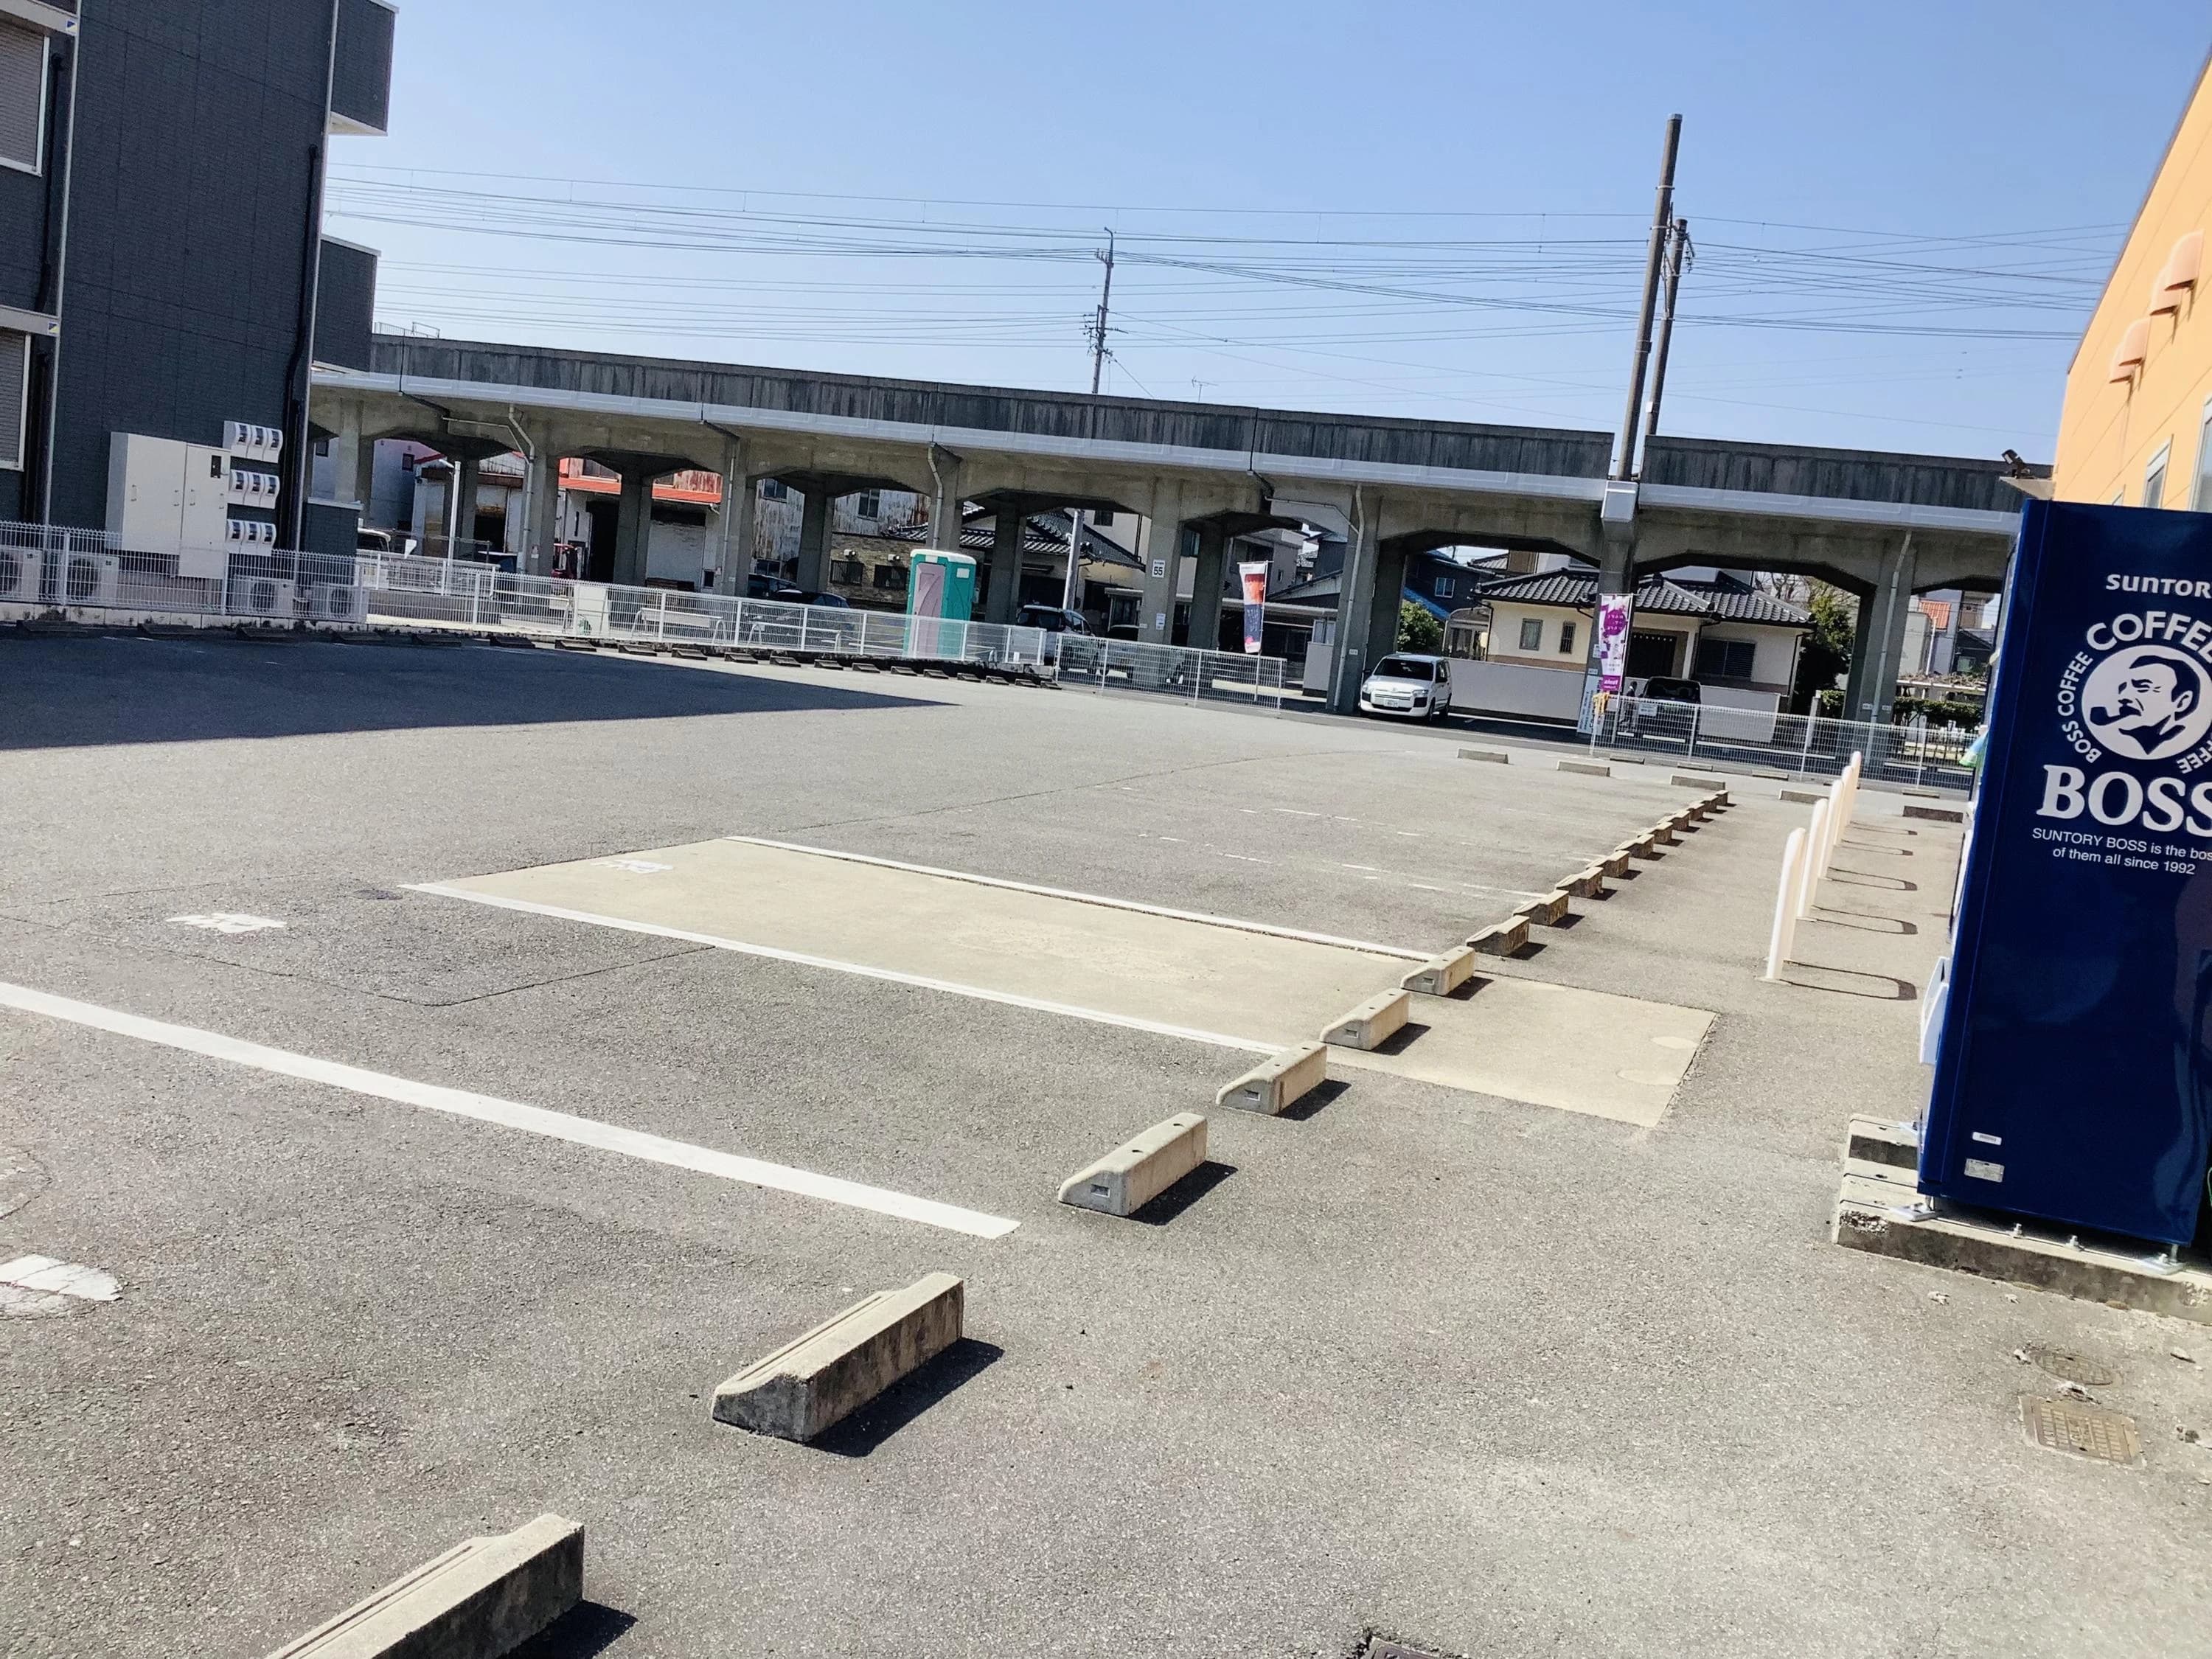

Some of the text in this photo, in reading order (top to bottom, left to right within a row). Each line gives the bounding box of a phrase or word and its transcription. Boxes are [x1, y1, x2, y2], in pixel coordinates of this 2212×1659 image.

[1153, 566, 1163, 576] 55
[2106, 574, 2212, 599] SUNTOR
[2057, 651, 2101, 763] BOSS COFFEE
[2036, 764, 2212, 838] BOSS
[2032, 827, 2103, 846] SUNTORY
[2107, 837, 2147, 852] BOSS
[2150, 842, 2162, 854] is
[2166, 844, 2186, 858] the
[2053, 847, 2196, 874] of them all since 1992
